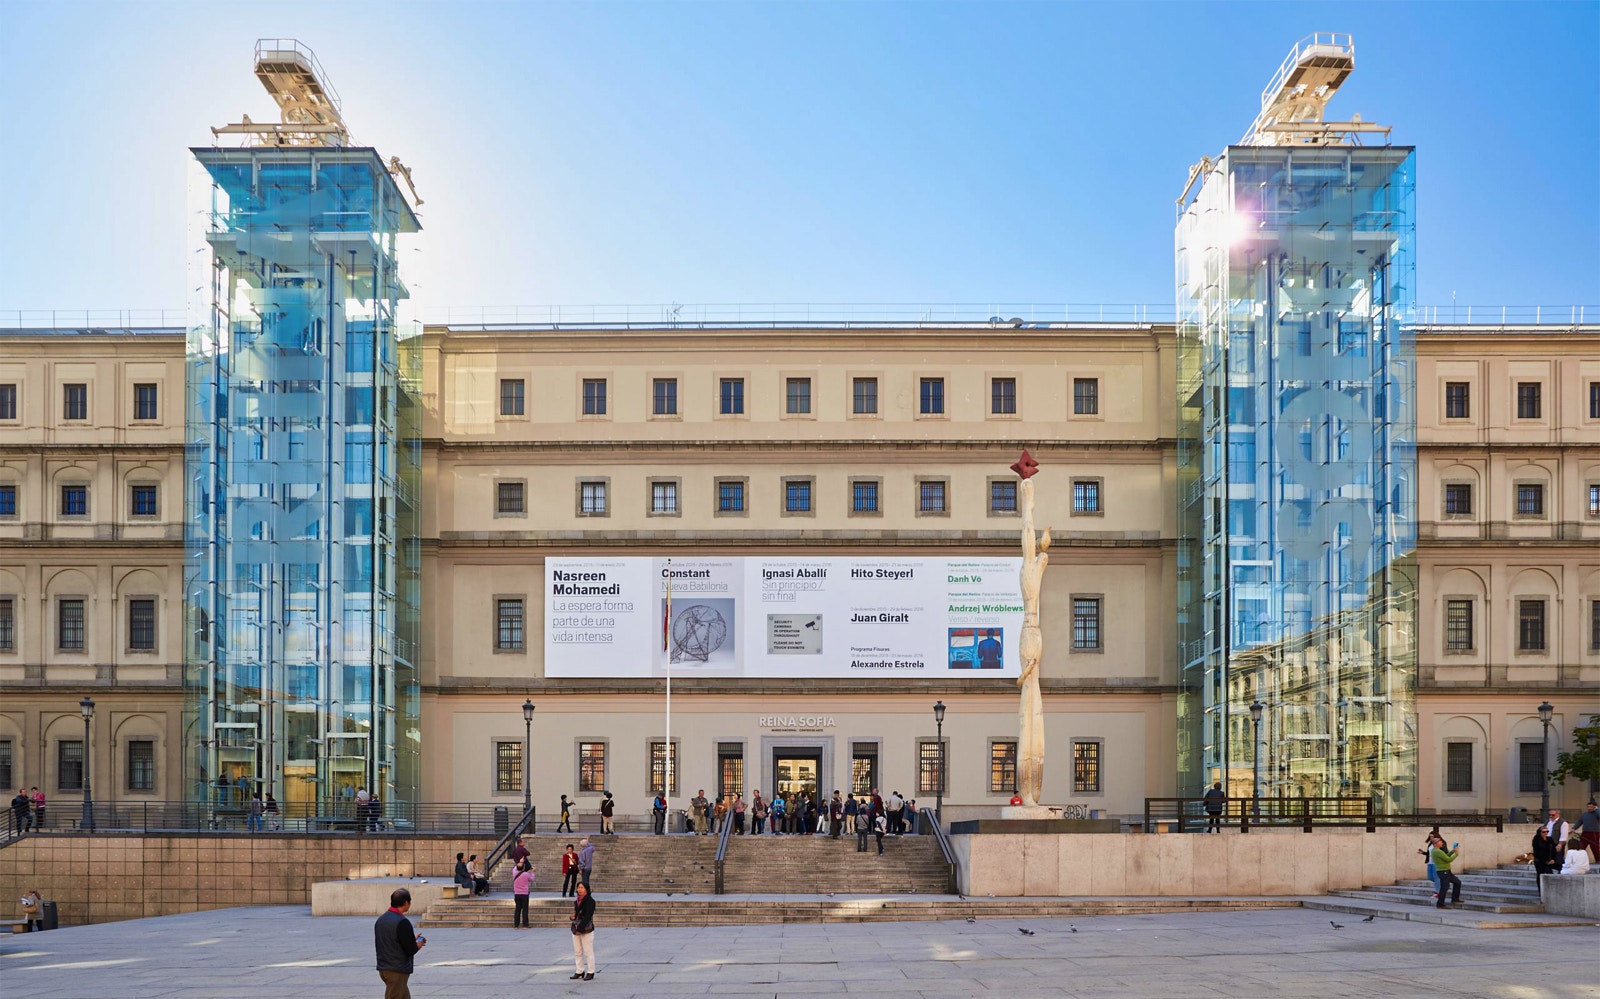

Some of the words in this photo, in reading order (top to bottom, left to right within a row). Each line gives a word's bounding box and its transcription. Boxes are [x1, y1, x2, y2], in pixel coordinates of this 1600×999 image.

[553, 570, 606, 581] Nasreen
[661, 569, 711, 578] Constant
[762, 569, 794, 580] Ignasi
[796, 569, 827, 578] Aballí
[851, 569, 874, 578] Hito
[875, 569, 914, 580] Steyerl
[948, 575, 970, 583] Danh
[553, 583, 620, 595] Mohamedi
[661, 581, 688, 591] Nueva
[689, 581, 728, 591] Babilonia
[762, 580, 777, 589] Sin
[778, 580, 817, 592] principio
[762, 592, 776, 600] sin
[777, 591, 796, 600] final
[553, 599, 566, 611] La
[567, 601, 602, 613] espera
[603, 599, 634, 611] forma
[948, 604, 980, 613] Andrzej
[552, 615, 580, 628] parte
[581, 615, 594, 626] de
[595, 618, 615, 627] una
[850, 613, 877, 622] Juan
[878, 613, 909, 622] Giralt
[552, 631, 574, 642] vida
[575, 631, 613, 641] intensa
[850, 660, 893, 668] Alexandre
[894, 660, 925, 668] Estrela
[759, 716, 796, 727] REINA
[798, 716, 836, 727] SOFIA
